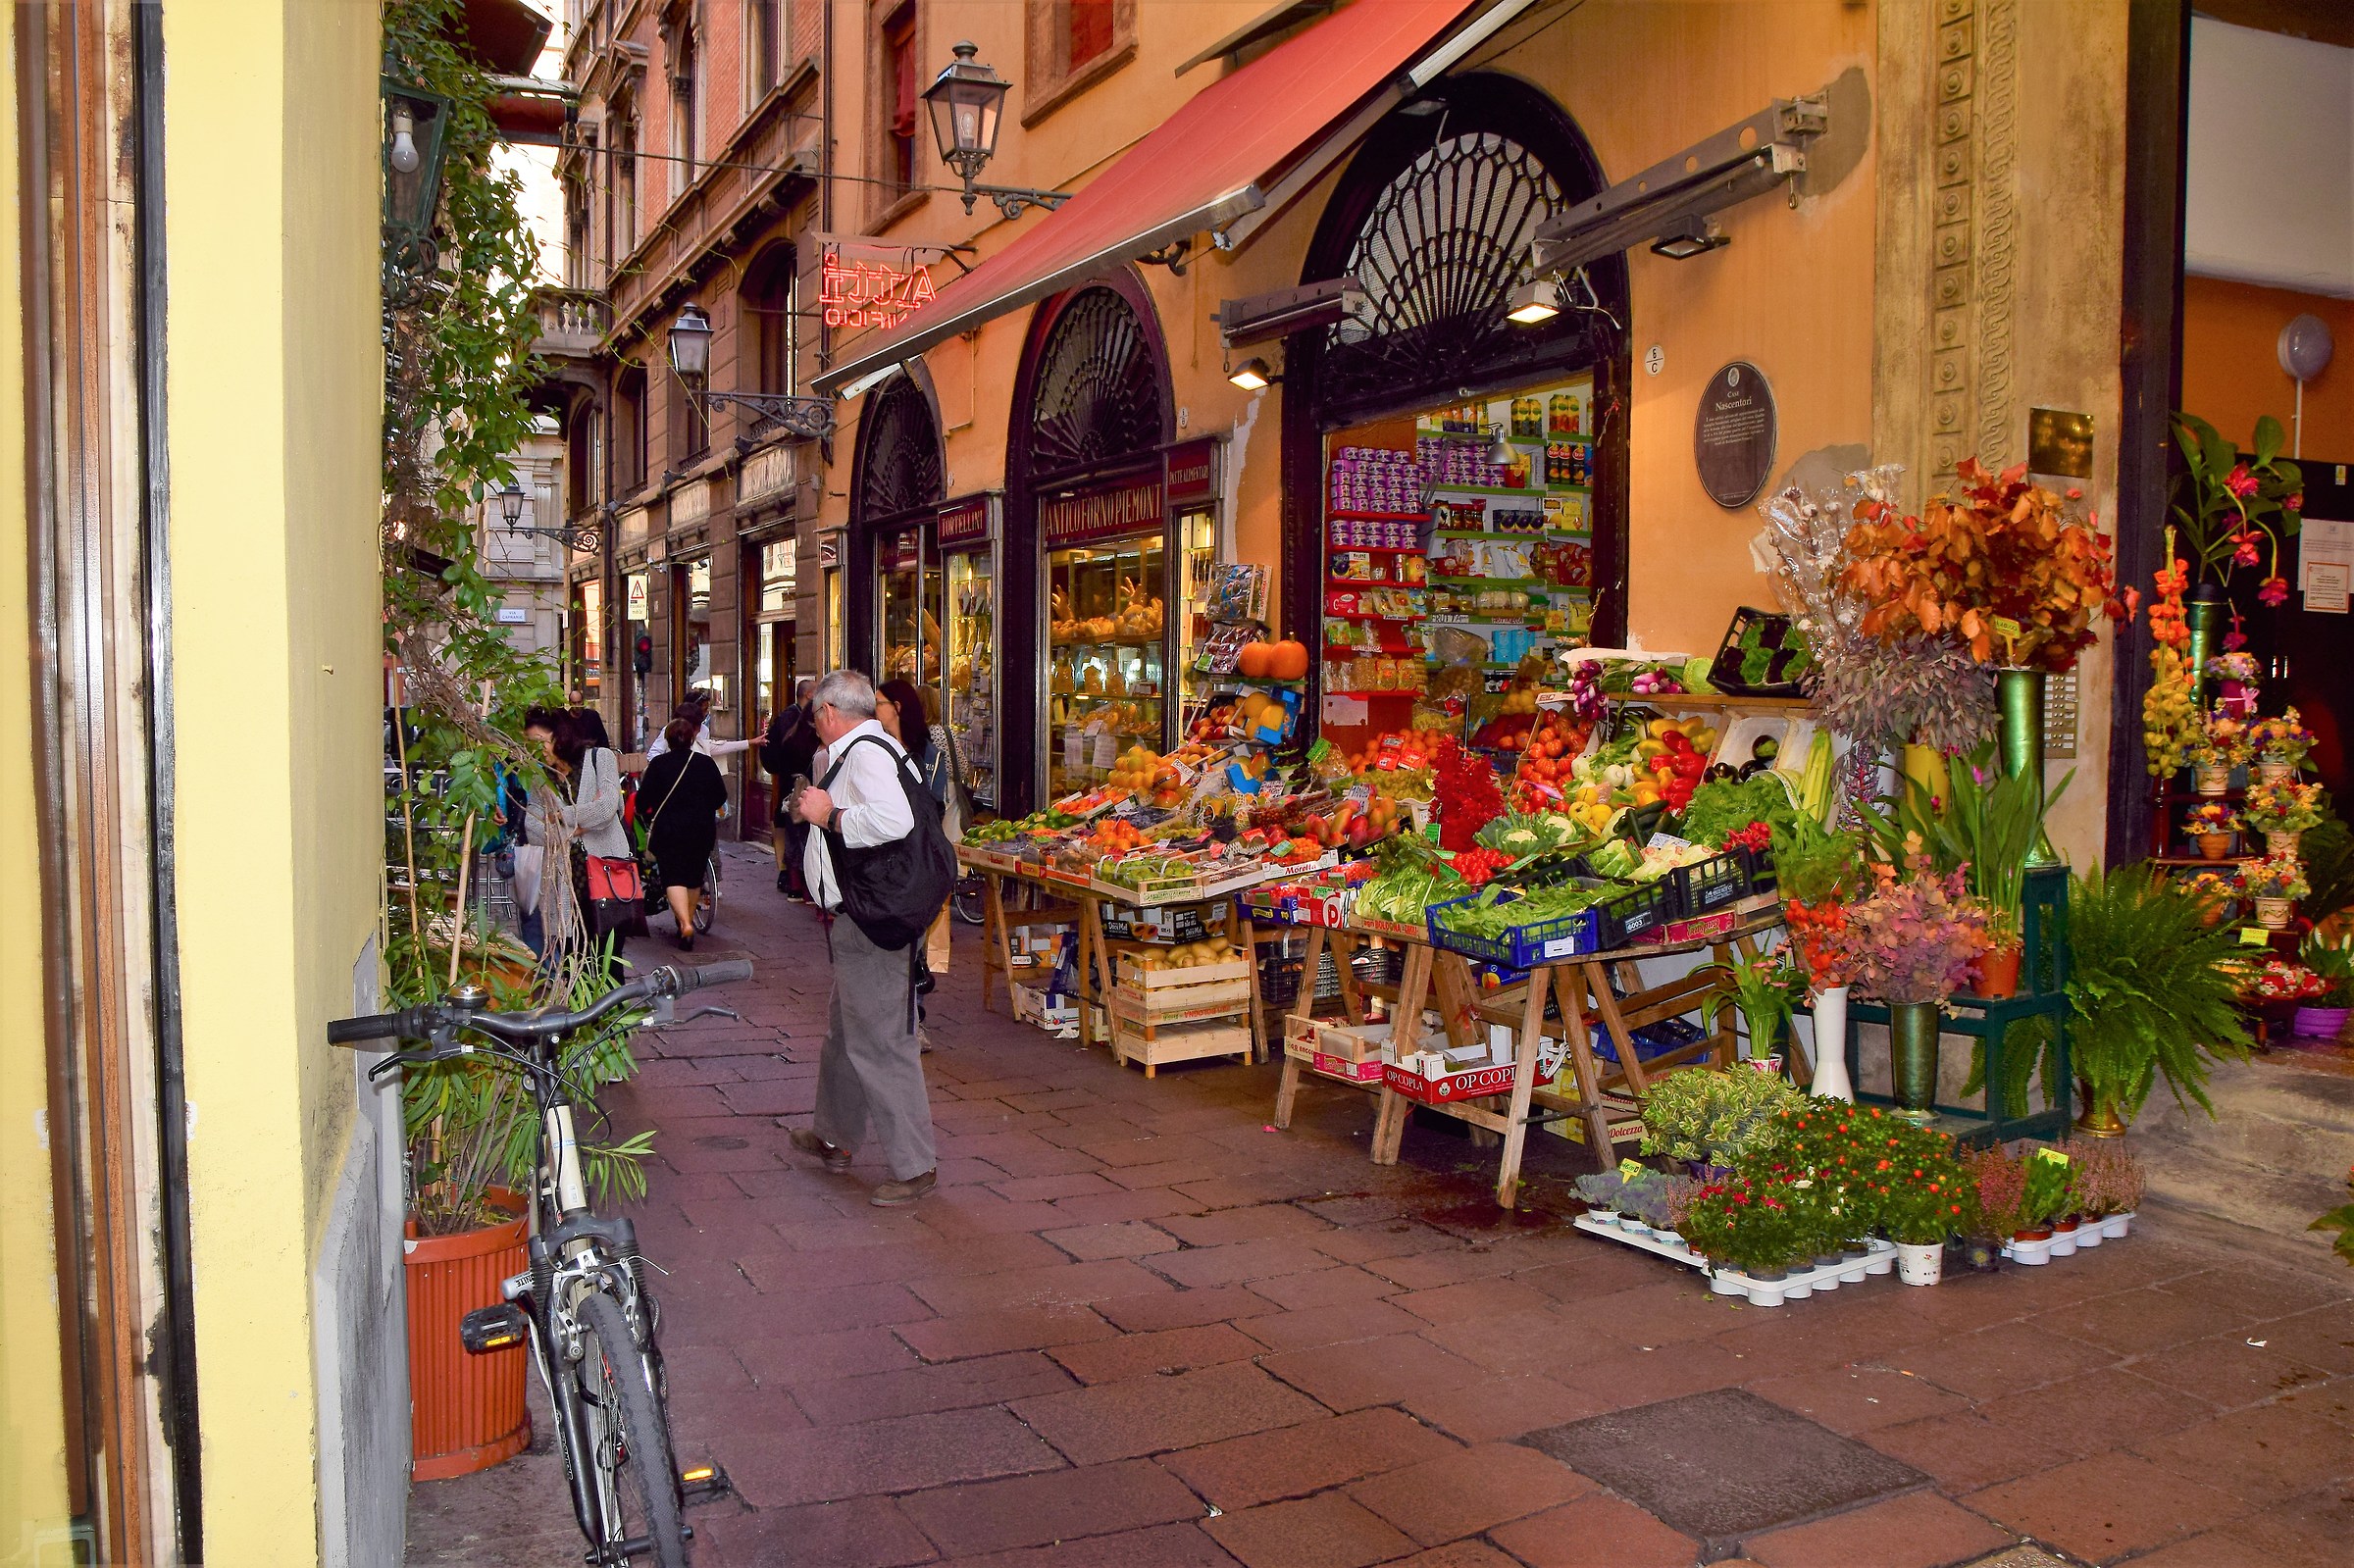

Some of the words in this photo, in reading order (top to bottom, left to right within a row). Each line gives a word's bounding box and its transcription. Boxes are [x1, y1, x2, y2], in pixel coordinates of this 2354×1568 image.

[1714, 396, 1753, 412] Nascentori
[1046, 501, 1080, 536] ANTICO
[1081, 493, 1114, 531] FORNO
[1115, 483, 1163, 526] PIEMONT
[941, 509, 983, 537] TORTELLINI
[1456, 1074, 1477, 1090] OP
[1609, 1125, 1643, 1138] Dolcezza
